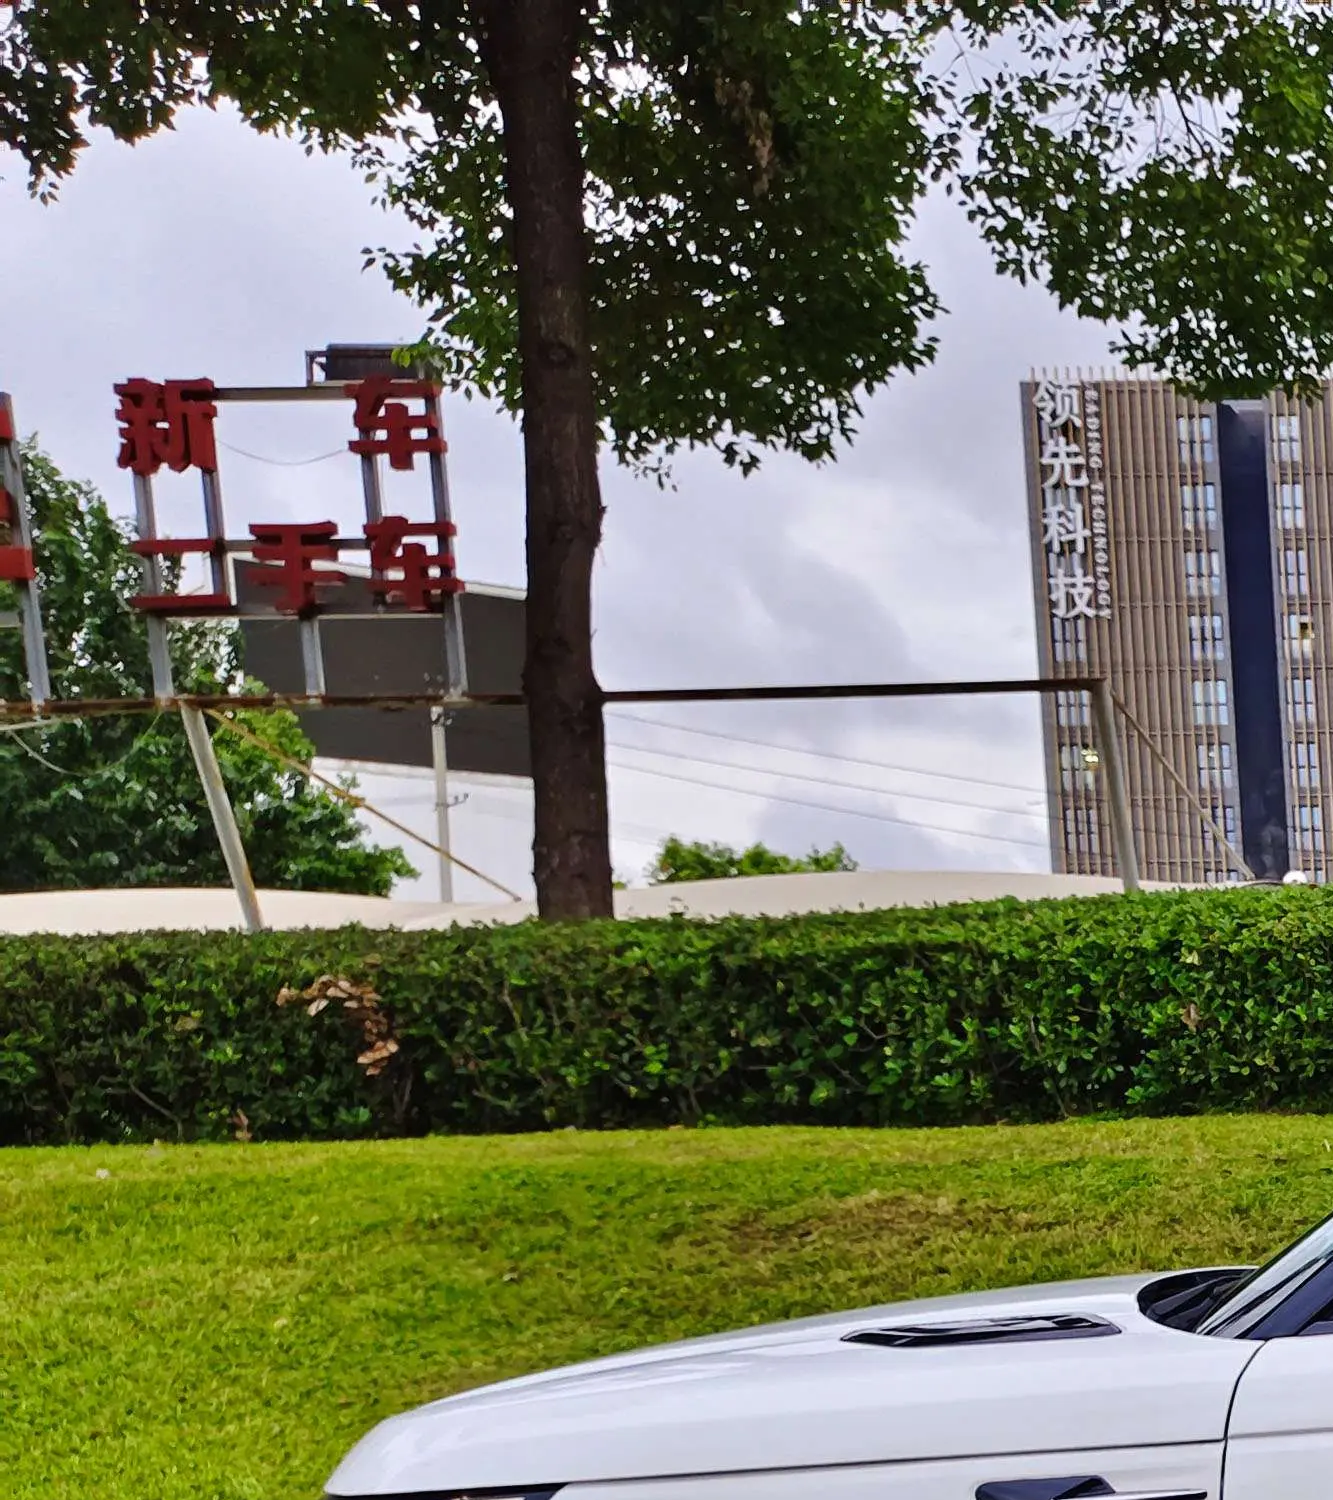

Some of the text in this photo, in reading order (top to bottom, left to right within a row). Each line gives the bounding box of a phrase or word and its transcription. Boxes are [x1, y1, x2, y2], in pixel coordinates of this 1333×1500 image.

[130, 516, 465, 614] 二手车
[1032, 376, 1097, 619] 领先科技
